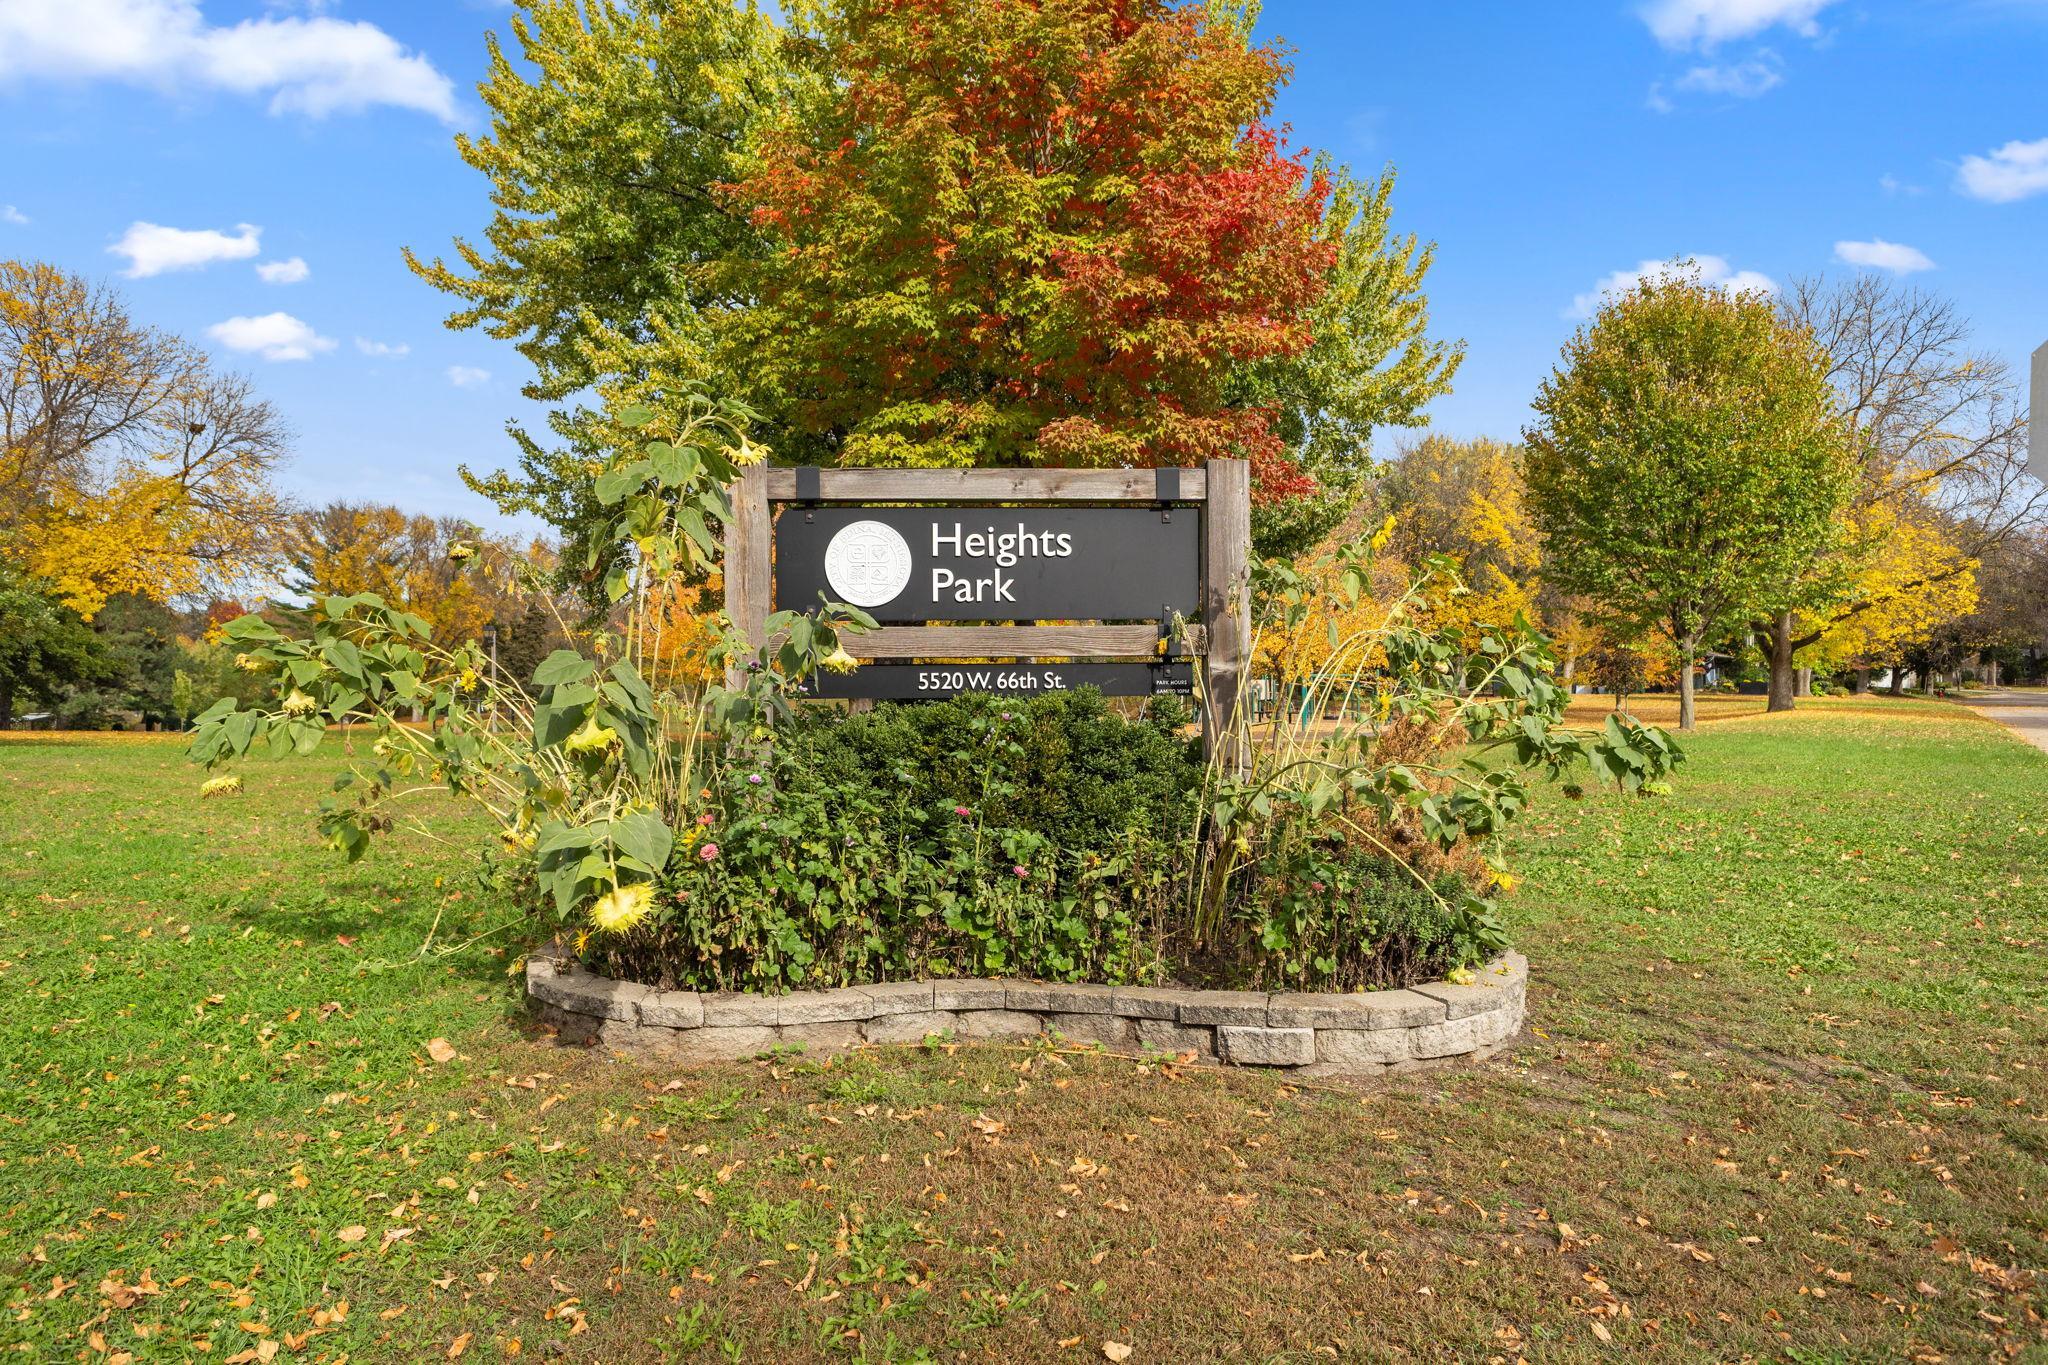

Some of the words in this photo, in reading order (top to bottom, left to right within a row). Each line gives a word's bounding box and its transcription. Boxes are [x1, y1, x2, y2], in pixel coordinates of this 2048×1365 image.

[932, 523, 1073, 567] Heights
[932, 568, 1017, 602] Park
[918, 672, 964, 690] 5520
[966, 672, 992, 690] W.
[996, 672, 1038, 690] 66th
[1043, 672, 1067, 690] St.
